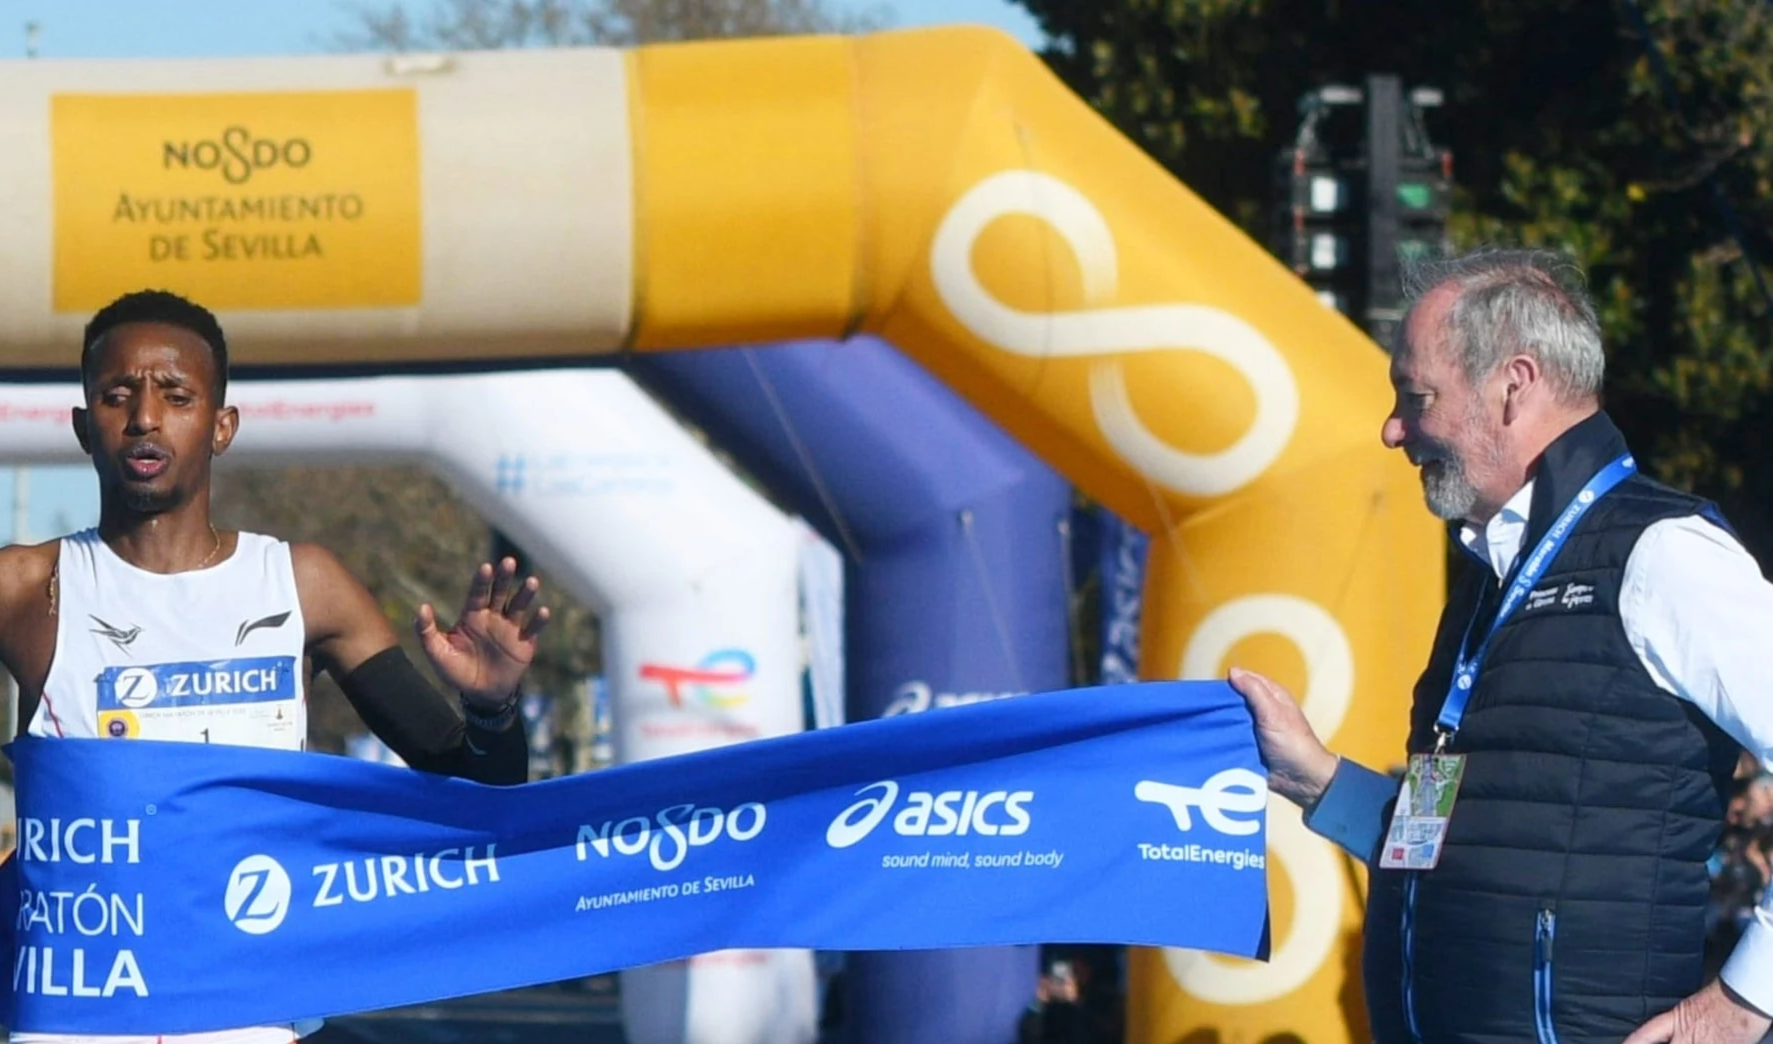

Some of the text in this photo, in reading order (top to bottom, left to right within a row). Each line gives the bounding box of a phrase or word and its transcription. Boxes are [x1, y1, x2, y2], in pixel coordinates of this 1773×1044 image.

[149, 229, 324, 262] DE SEVILLA
[167, 669, 277, 697] ZURICH
[893, 791, 1035, 836] asics
[882, 849, 1064, 869] sound mind, sound body
[1137, 842, 1266, 869] TotalEnergies
[312, 843, 502, 908] ZURICH
[575, 874, 755, 912] AYUNTAMIENTO DE SEVILLA
[17, 883, 144, 937] RATÓN
